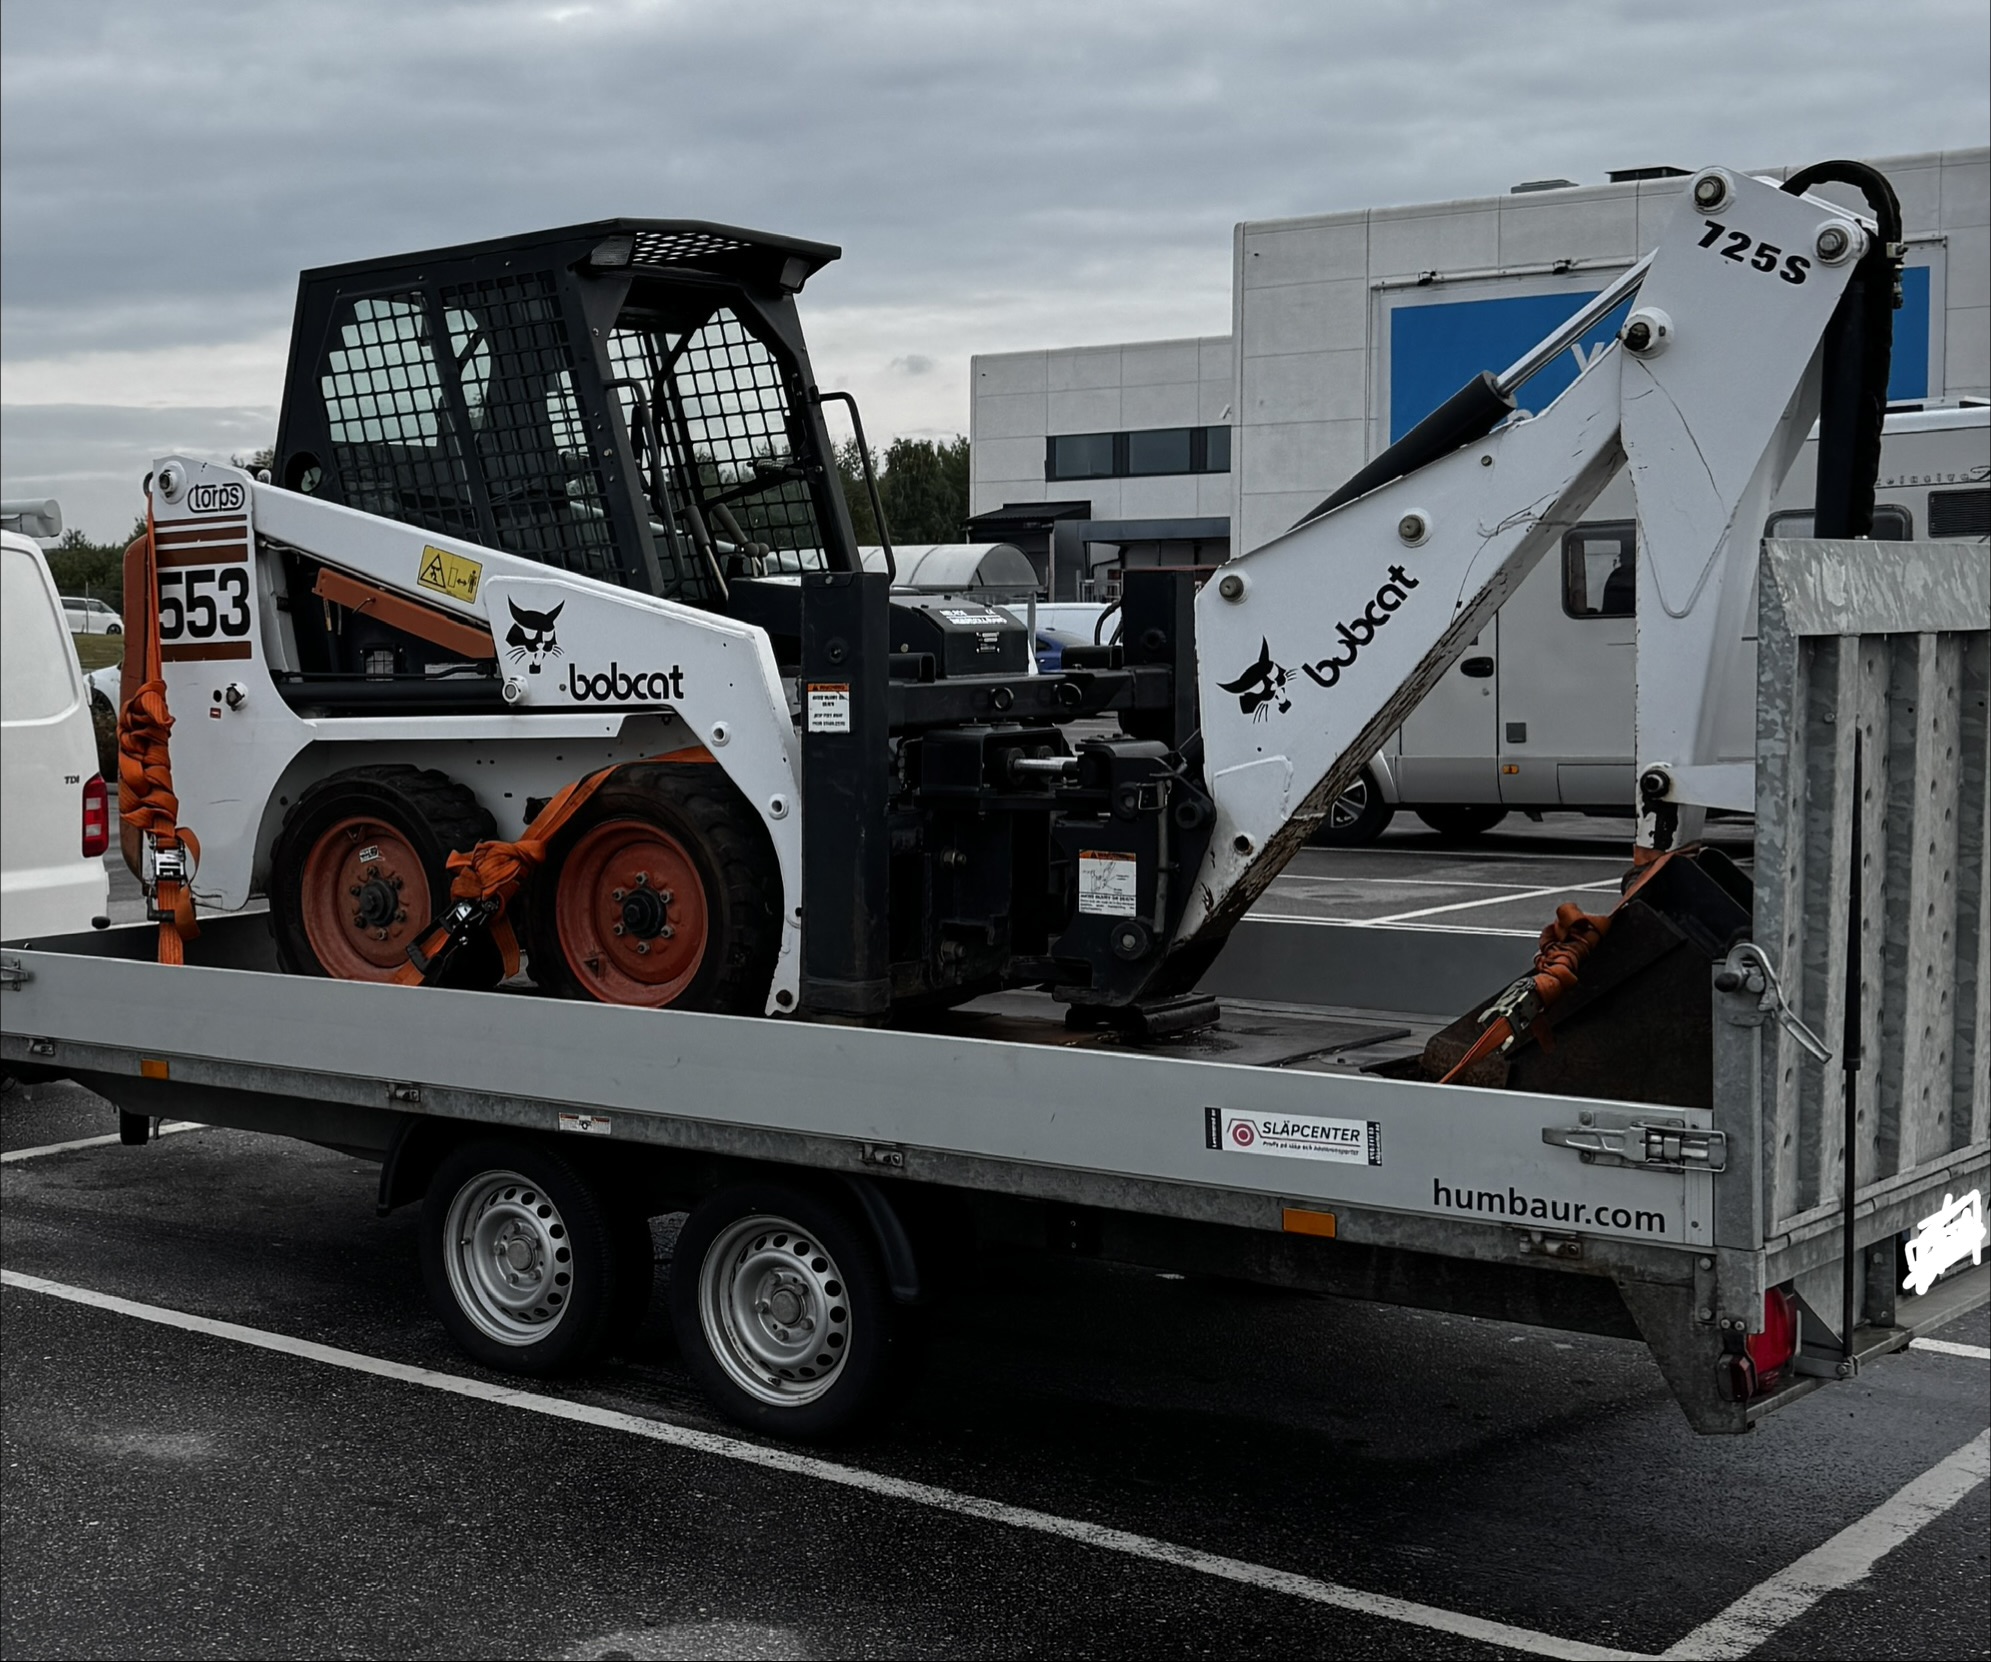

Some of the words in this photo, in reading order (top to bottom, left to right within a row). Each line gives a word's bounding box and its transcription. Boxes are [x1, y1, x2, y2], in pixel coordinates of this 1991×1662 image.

[1698, 220, 1811, 285] 725S
[194, 484, 239, 511] torps
[157, 567, 251, 640] 553
[1301, 564, 1420, 688] bobcat
[569, 661, 684, 701] bobcat
[64, 774, 80, 785] TDI
[1262, 1120, 1361, 1142] SLÄPCENTER
[1433, 1178, 1666, 1233] humbaur.com
